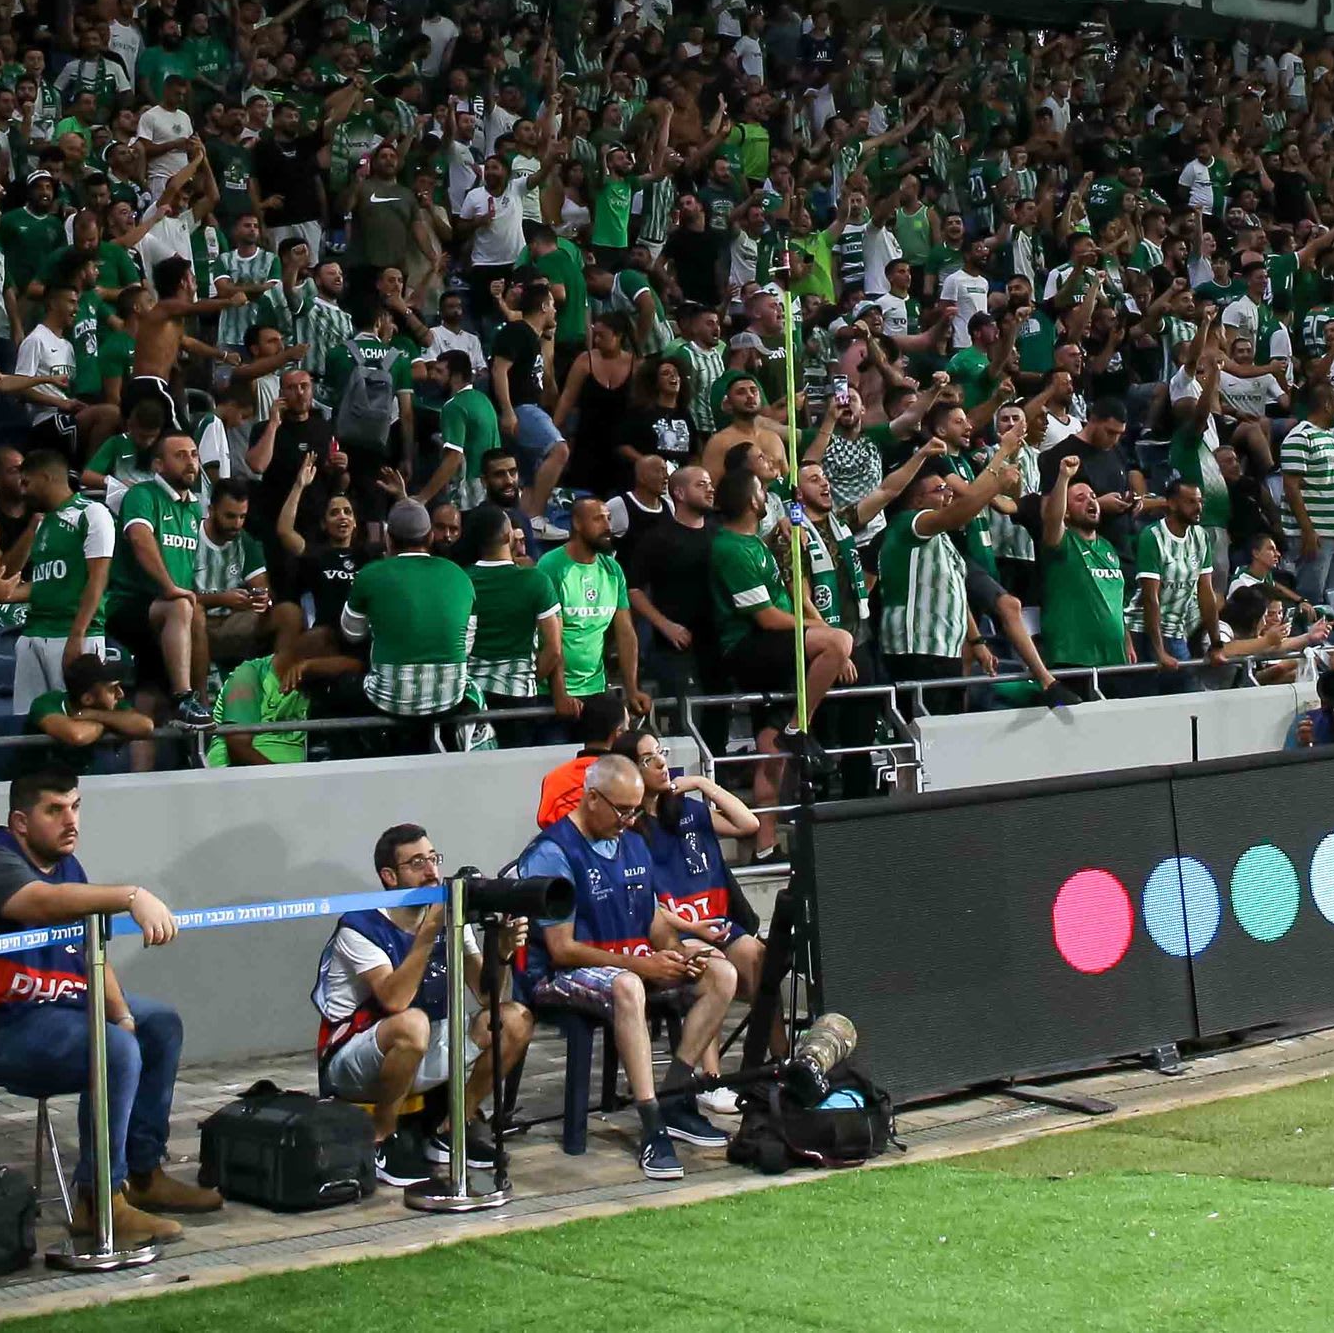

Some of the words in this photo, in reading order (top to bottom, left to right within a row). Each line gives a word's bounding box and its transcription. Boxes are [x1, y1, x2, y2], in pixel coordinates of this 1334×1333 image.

[33, 559, 67, 582] LVO
[206, 910, 235, 924] מכבי
[237, 905, 276, 921] כדורגל
[278, 901, 316, 919] מועדון
[175, 912, 203, 927] חיפה
[24, 932, 50, 947] מכבי
[50, 924, 85, 943] כדורגל
